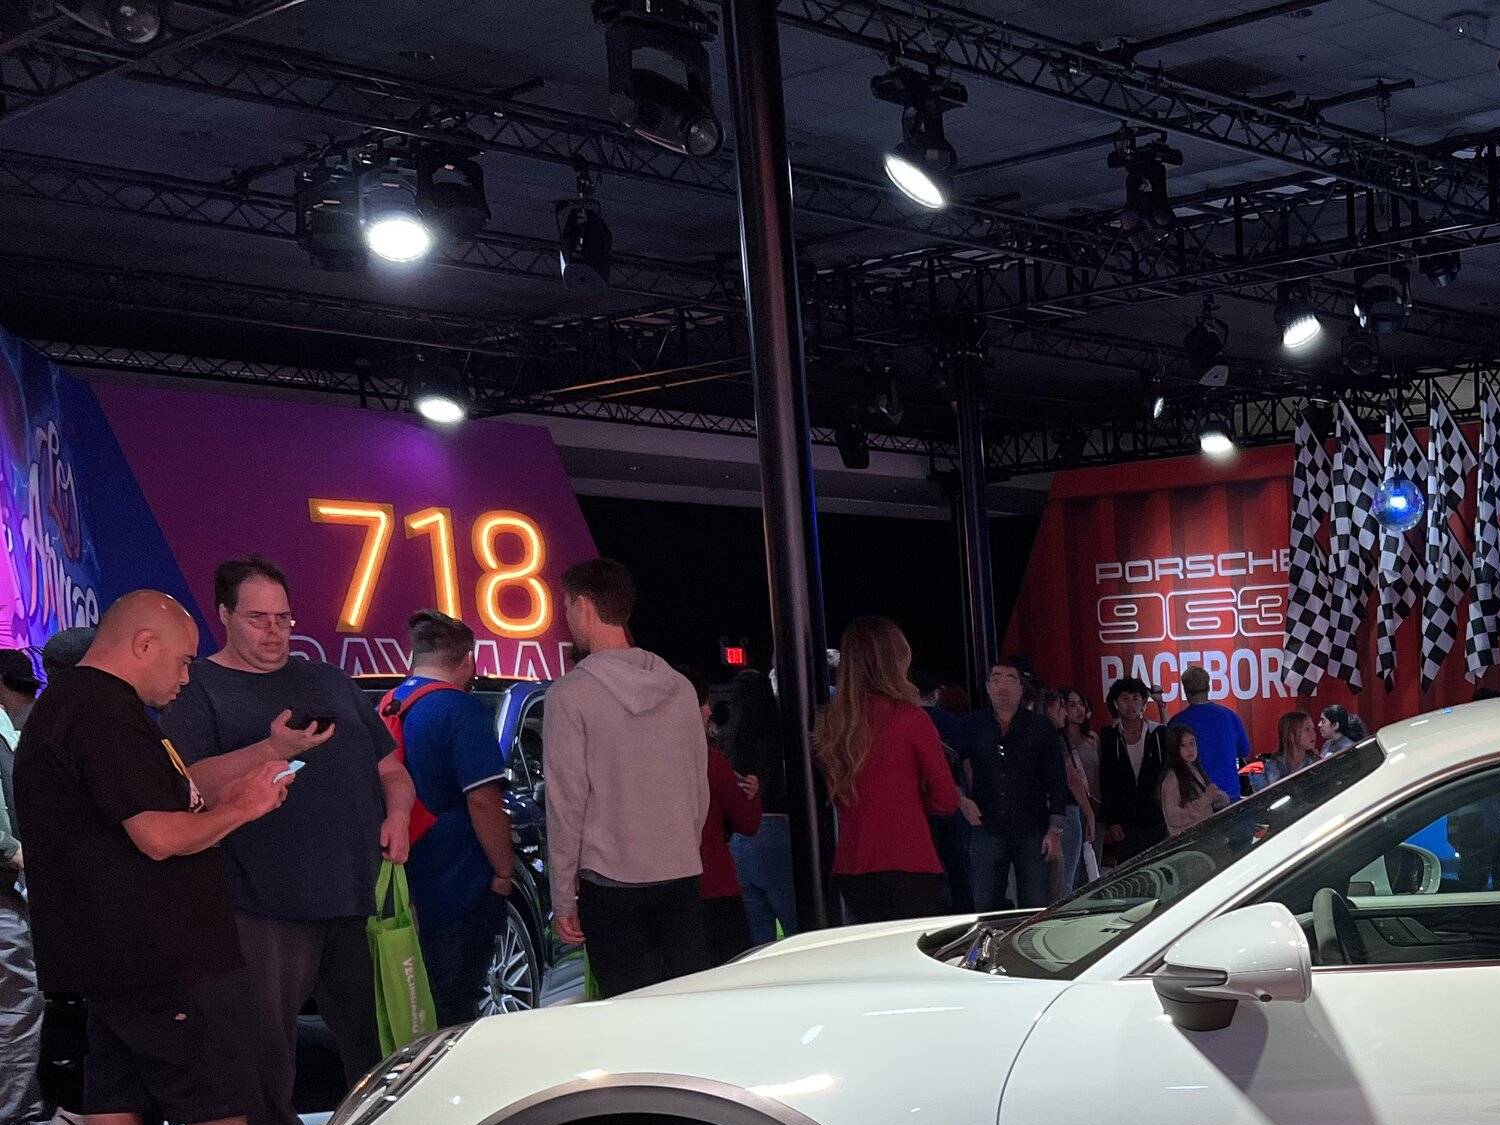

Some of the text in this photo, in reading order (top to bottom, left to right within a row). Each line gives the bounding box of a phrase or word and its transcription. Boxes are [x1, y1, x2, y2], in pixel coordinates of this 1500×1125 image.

[308, 498, 553, 639] 718
[1098, 583, 1291, 644] 963
[1100, 648, 1318, 704] RACEBOR
